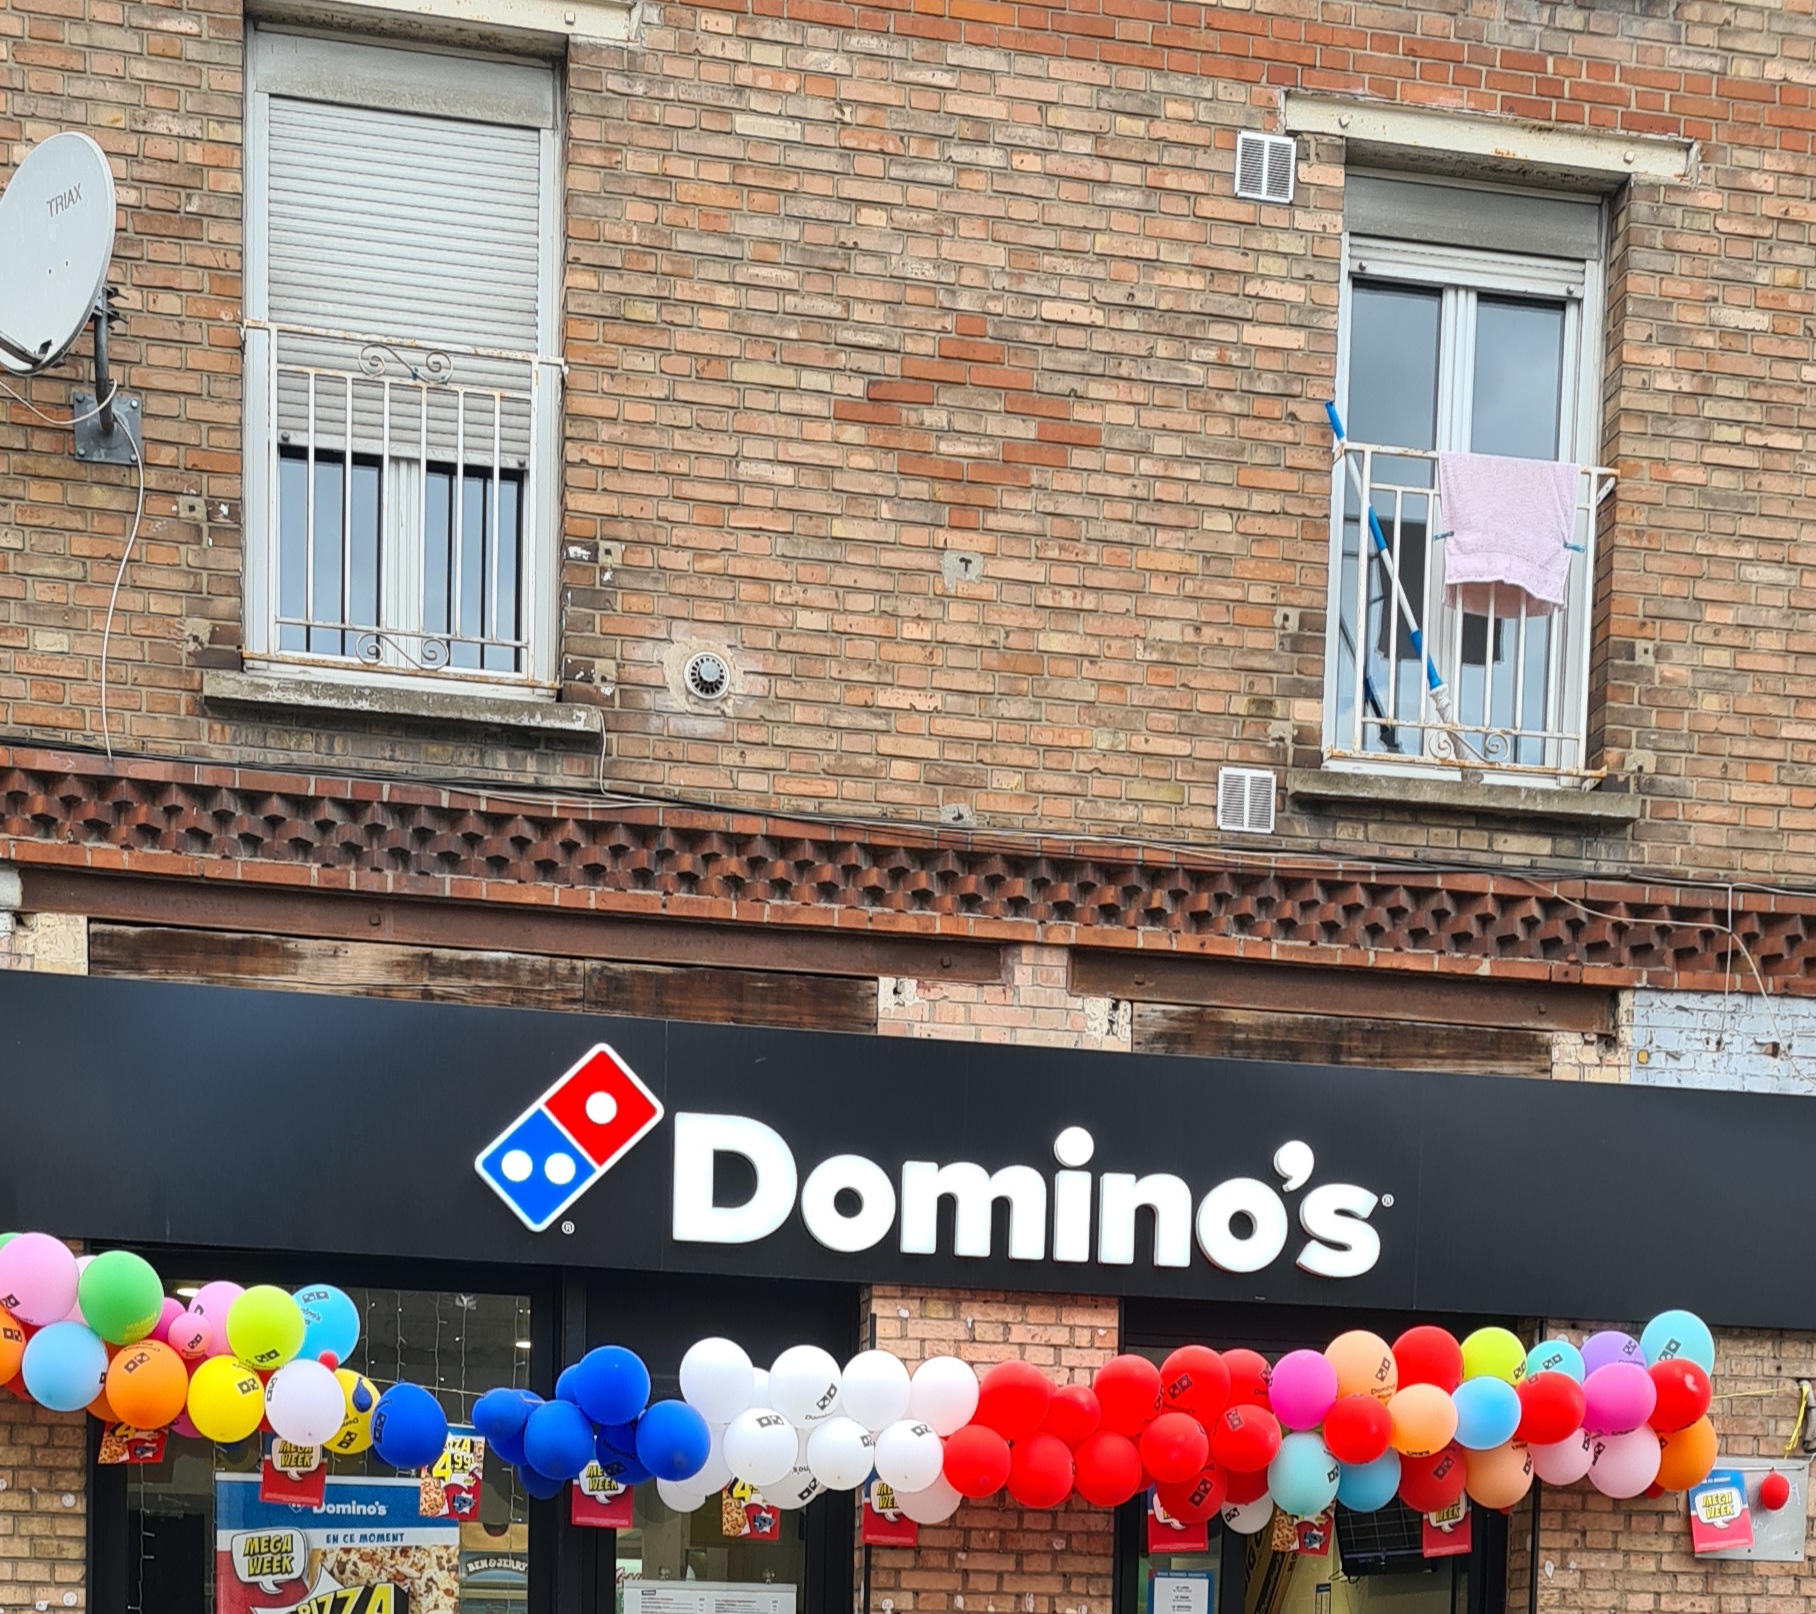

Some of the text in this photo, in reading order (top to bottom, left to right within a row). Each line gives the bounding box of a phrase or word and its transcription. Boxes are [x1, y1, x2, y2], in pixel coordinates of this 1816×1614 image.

[46, 183, 83, 218] TRIAX
[672, 1110, 1381, 1279] Domino's
[446, 1437, 471, 1453] IZZA
[280, 1453, 313, 1468] WEEK
[313, 1500, 387, 1516] Domino's
[1702, 1491, 1734, 1508] MEGA
[1436, 1507, 1461, 1524] WEEK
[1705, 1504, 1735, 1519] WEEK
[244, 1534, 294, 1556] MEGA
[325, 1532, 405, 1545] EN CE MOMENT
[247, 1554, 295, 1577] WEEK
